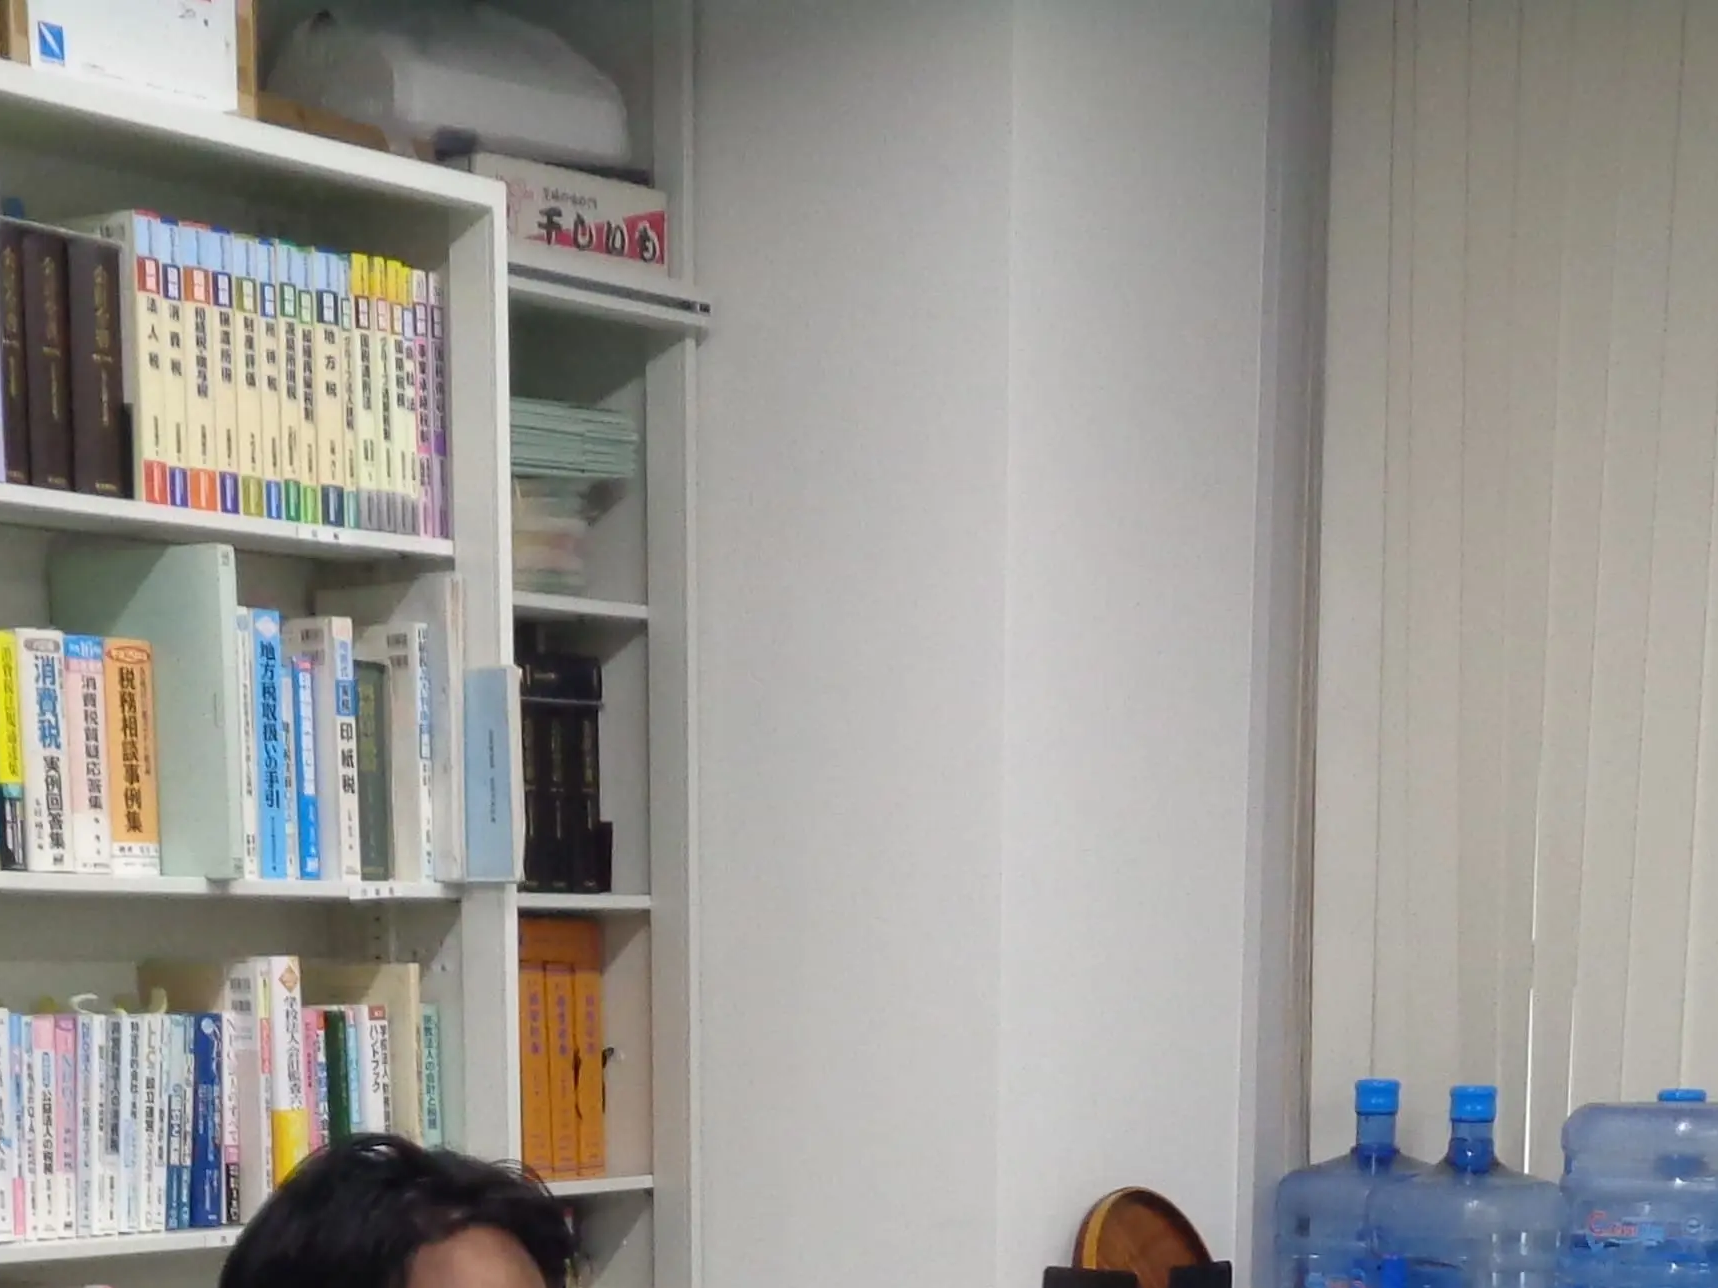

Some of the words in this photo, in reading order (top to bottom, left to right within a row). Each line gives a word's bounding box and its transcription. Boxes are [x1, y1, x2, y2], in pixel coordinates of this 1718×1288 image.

[537, 206, 661, 263] 干しいも
[146, 296, 160, 369] 法人税
[168, 304, 182, 377] 消費税
[323, 328, 337, 398] 地方税
[34, 654, 62, 750] 消費税
[259, 641, 281, 809] 地方税取扱いの手引
[80, 674, 104, 810] 消費税質疑応答集
[117, 667, 143, 834] 税務相談事例集
[339, 722, 356, 795] 印紙税
[43, 753, 66, 850] 実例回答集
[369, 1024, 381, 1093] ハンドブック
